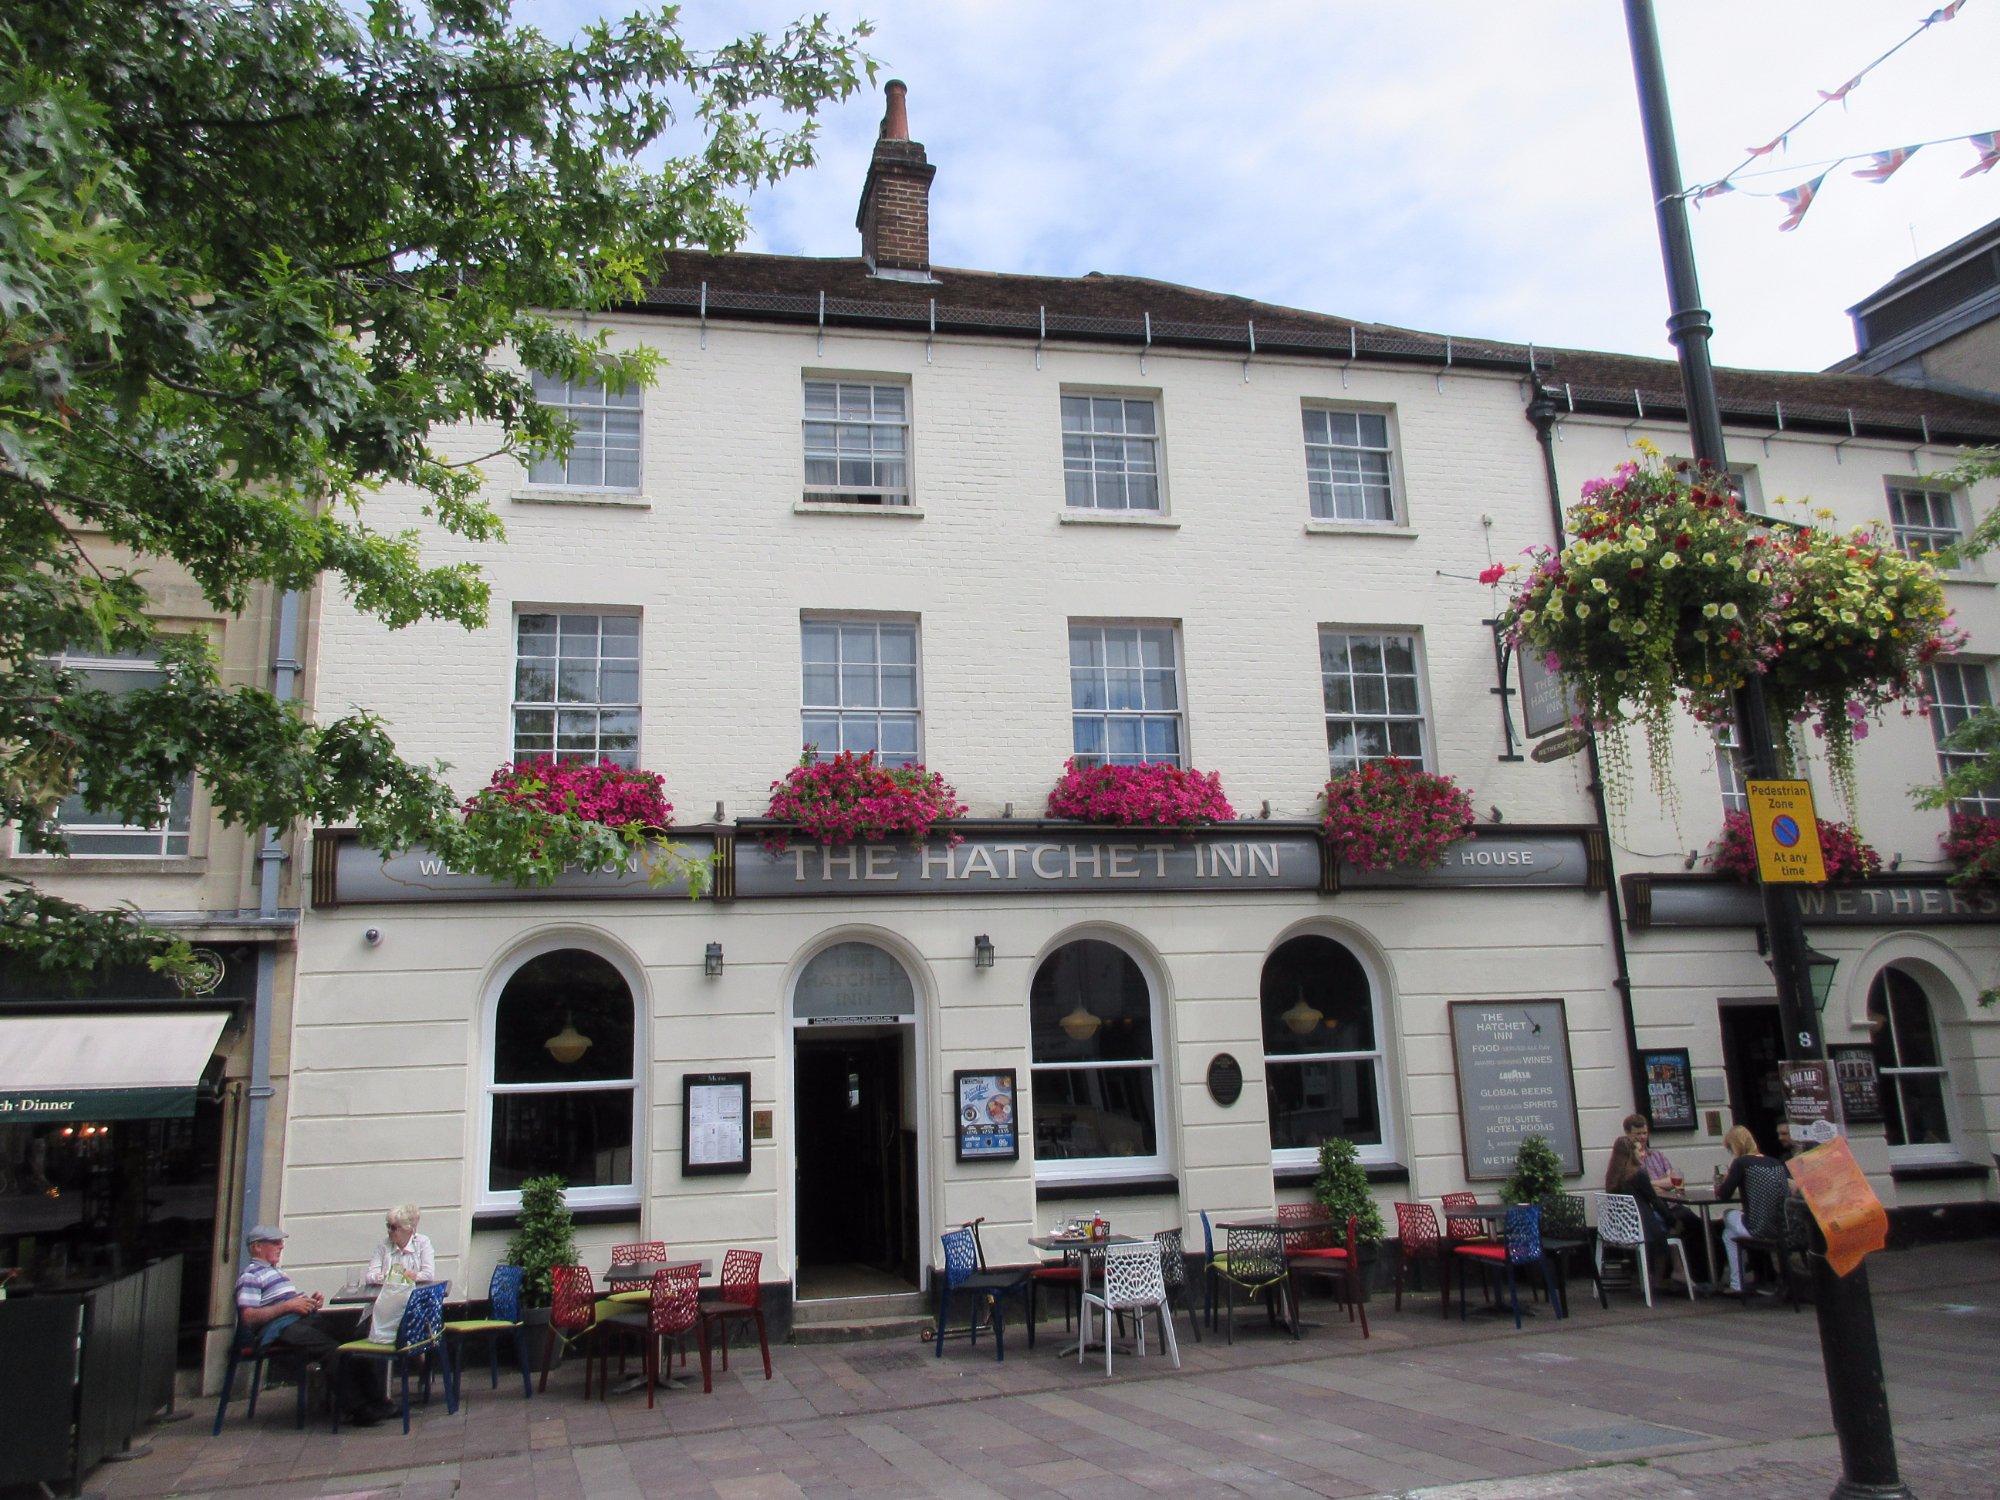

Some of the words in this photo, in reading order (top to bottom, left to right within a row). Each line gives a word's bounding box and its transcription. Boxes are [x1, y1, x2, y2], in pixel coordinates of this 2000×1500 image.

[1751, 786, 1806, 796] Pedestrian
[1768, 799, 1794, 809] Zone
[786, 845, 899, 880] THE
[920, 843, 1175, 880] HATCHET
[1193, 842, 1280, 878] INN
[1461, 851, 1534, 866] HOUSE
[1773, 852, 1788, 862] At
[1790, 853, 1808, 864] any
[1781, 866, 1805, 876] time
[1482, 1013, 1504, 1021] THE
[1476, 1022, 1527, 1032] HATCHET
[1493, 1032, 1513, 1040] INN
[1472, 1044, 1500, 1053] FOOD
[1522, 1055, 1553, 1064] WINES
[1480, 1088, 1520, 1097] GLOBAL
[1521, 1087, 1553, 1095] BEERS
[21, 1099, 75, 1111] Dinner
[1523, 1100, 1558, 1109] SPIRITS
[1486, 1124, 1518, 1133] HOTEL
[1520, 1122, 1555, 1131] ROOMS
